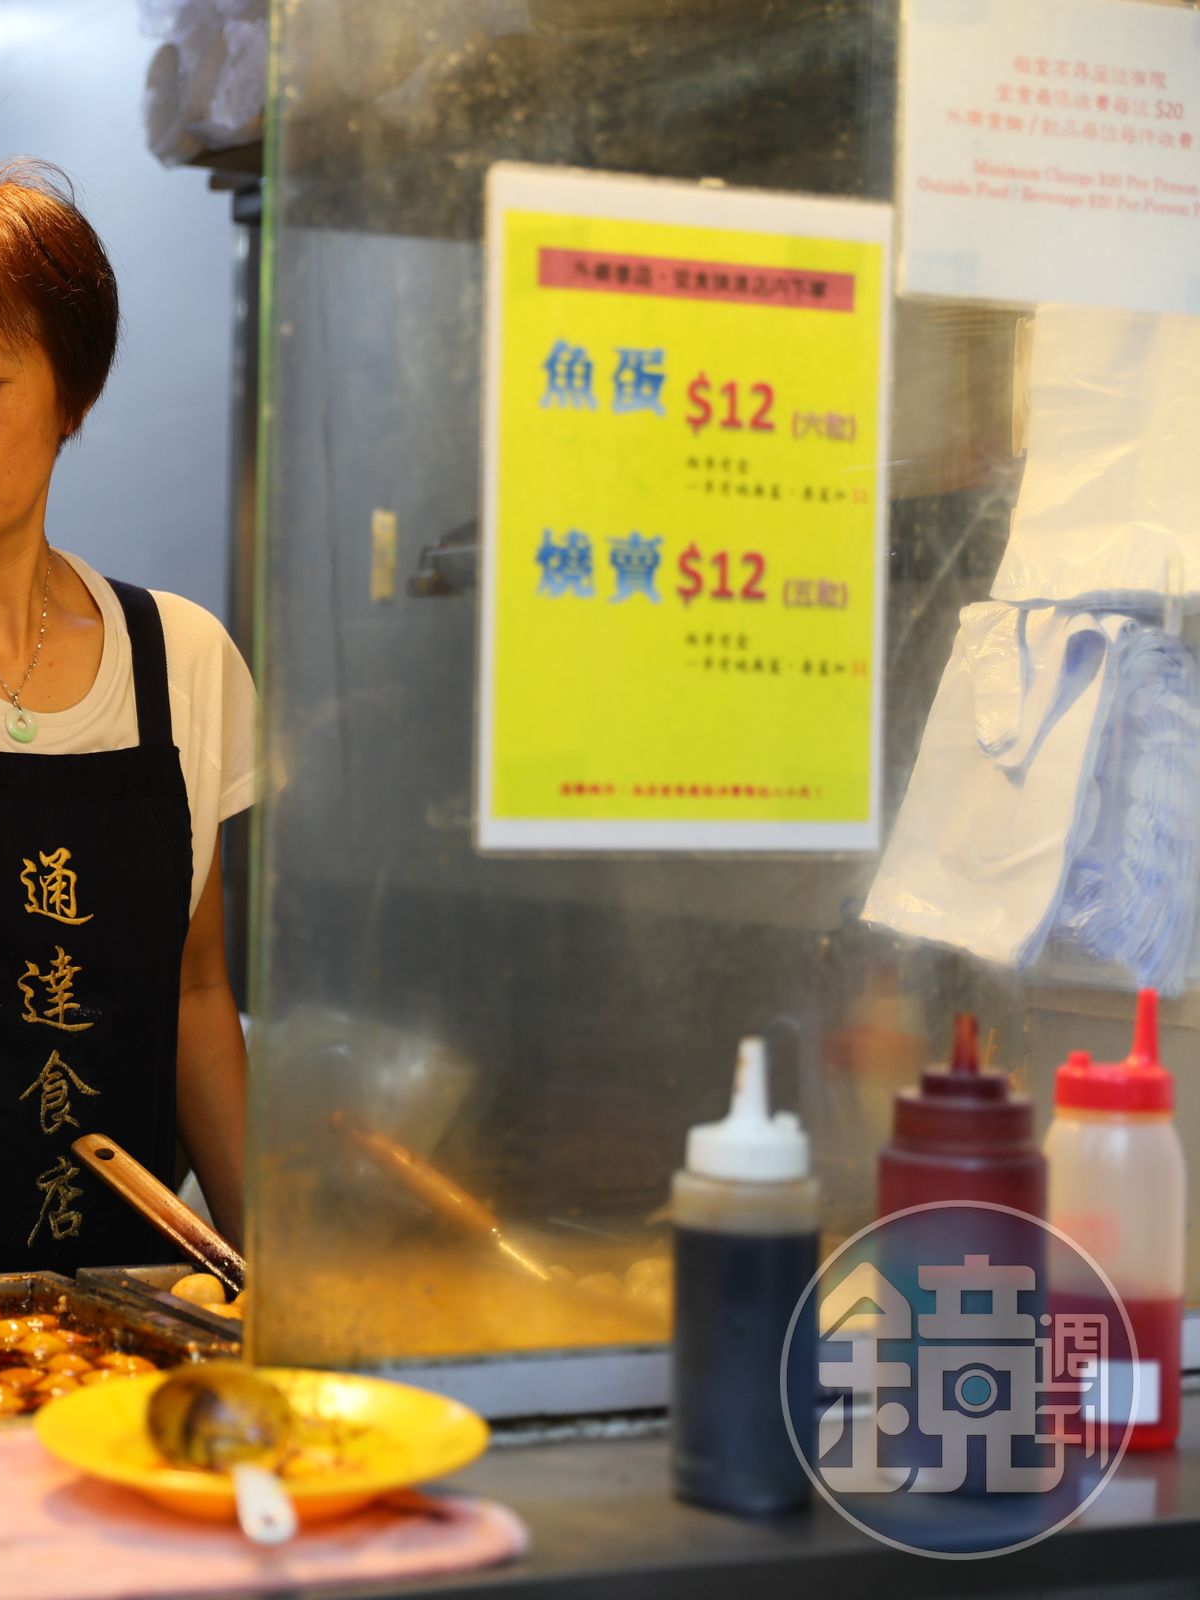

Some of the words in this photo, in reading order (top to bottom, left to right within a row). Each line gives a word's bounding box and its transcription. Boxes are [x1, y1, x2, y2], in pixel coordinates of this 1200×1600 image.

[540, 339, 668, 418] 魚蛋
[684, 370, 777, 438] $12
[535, 528, 665, 606] 燒賣
[676, 542, 768, 609] $12
[16, 846, 102, 1249] 通達食店
